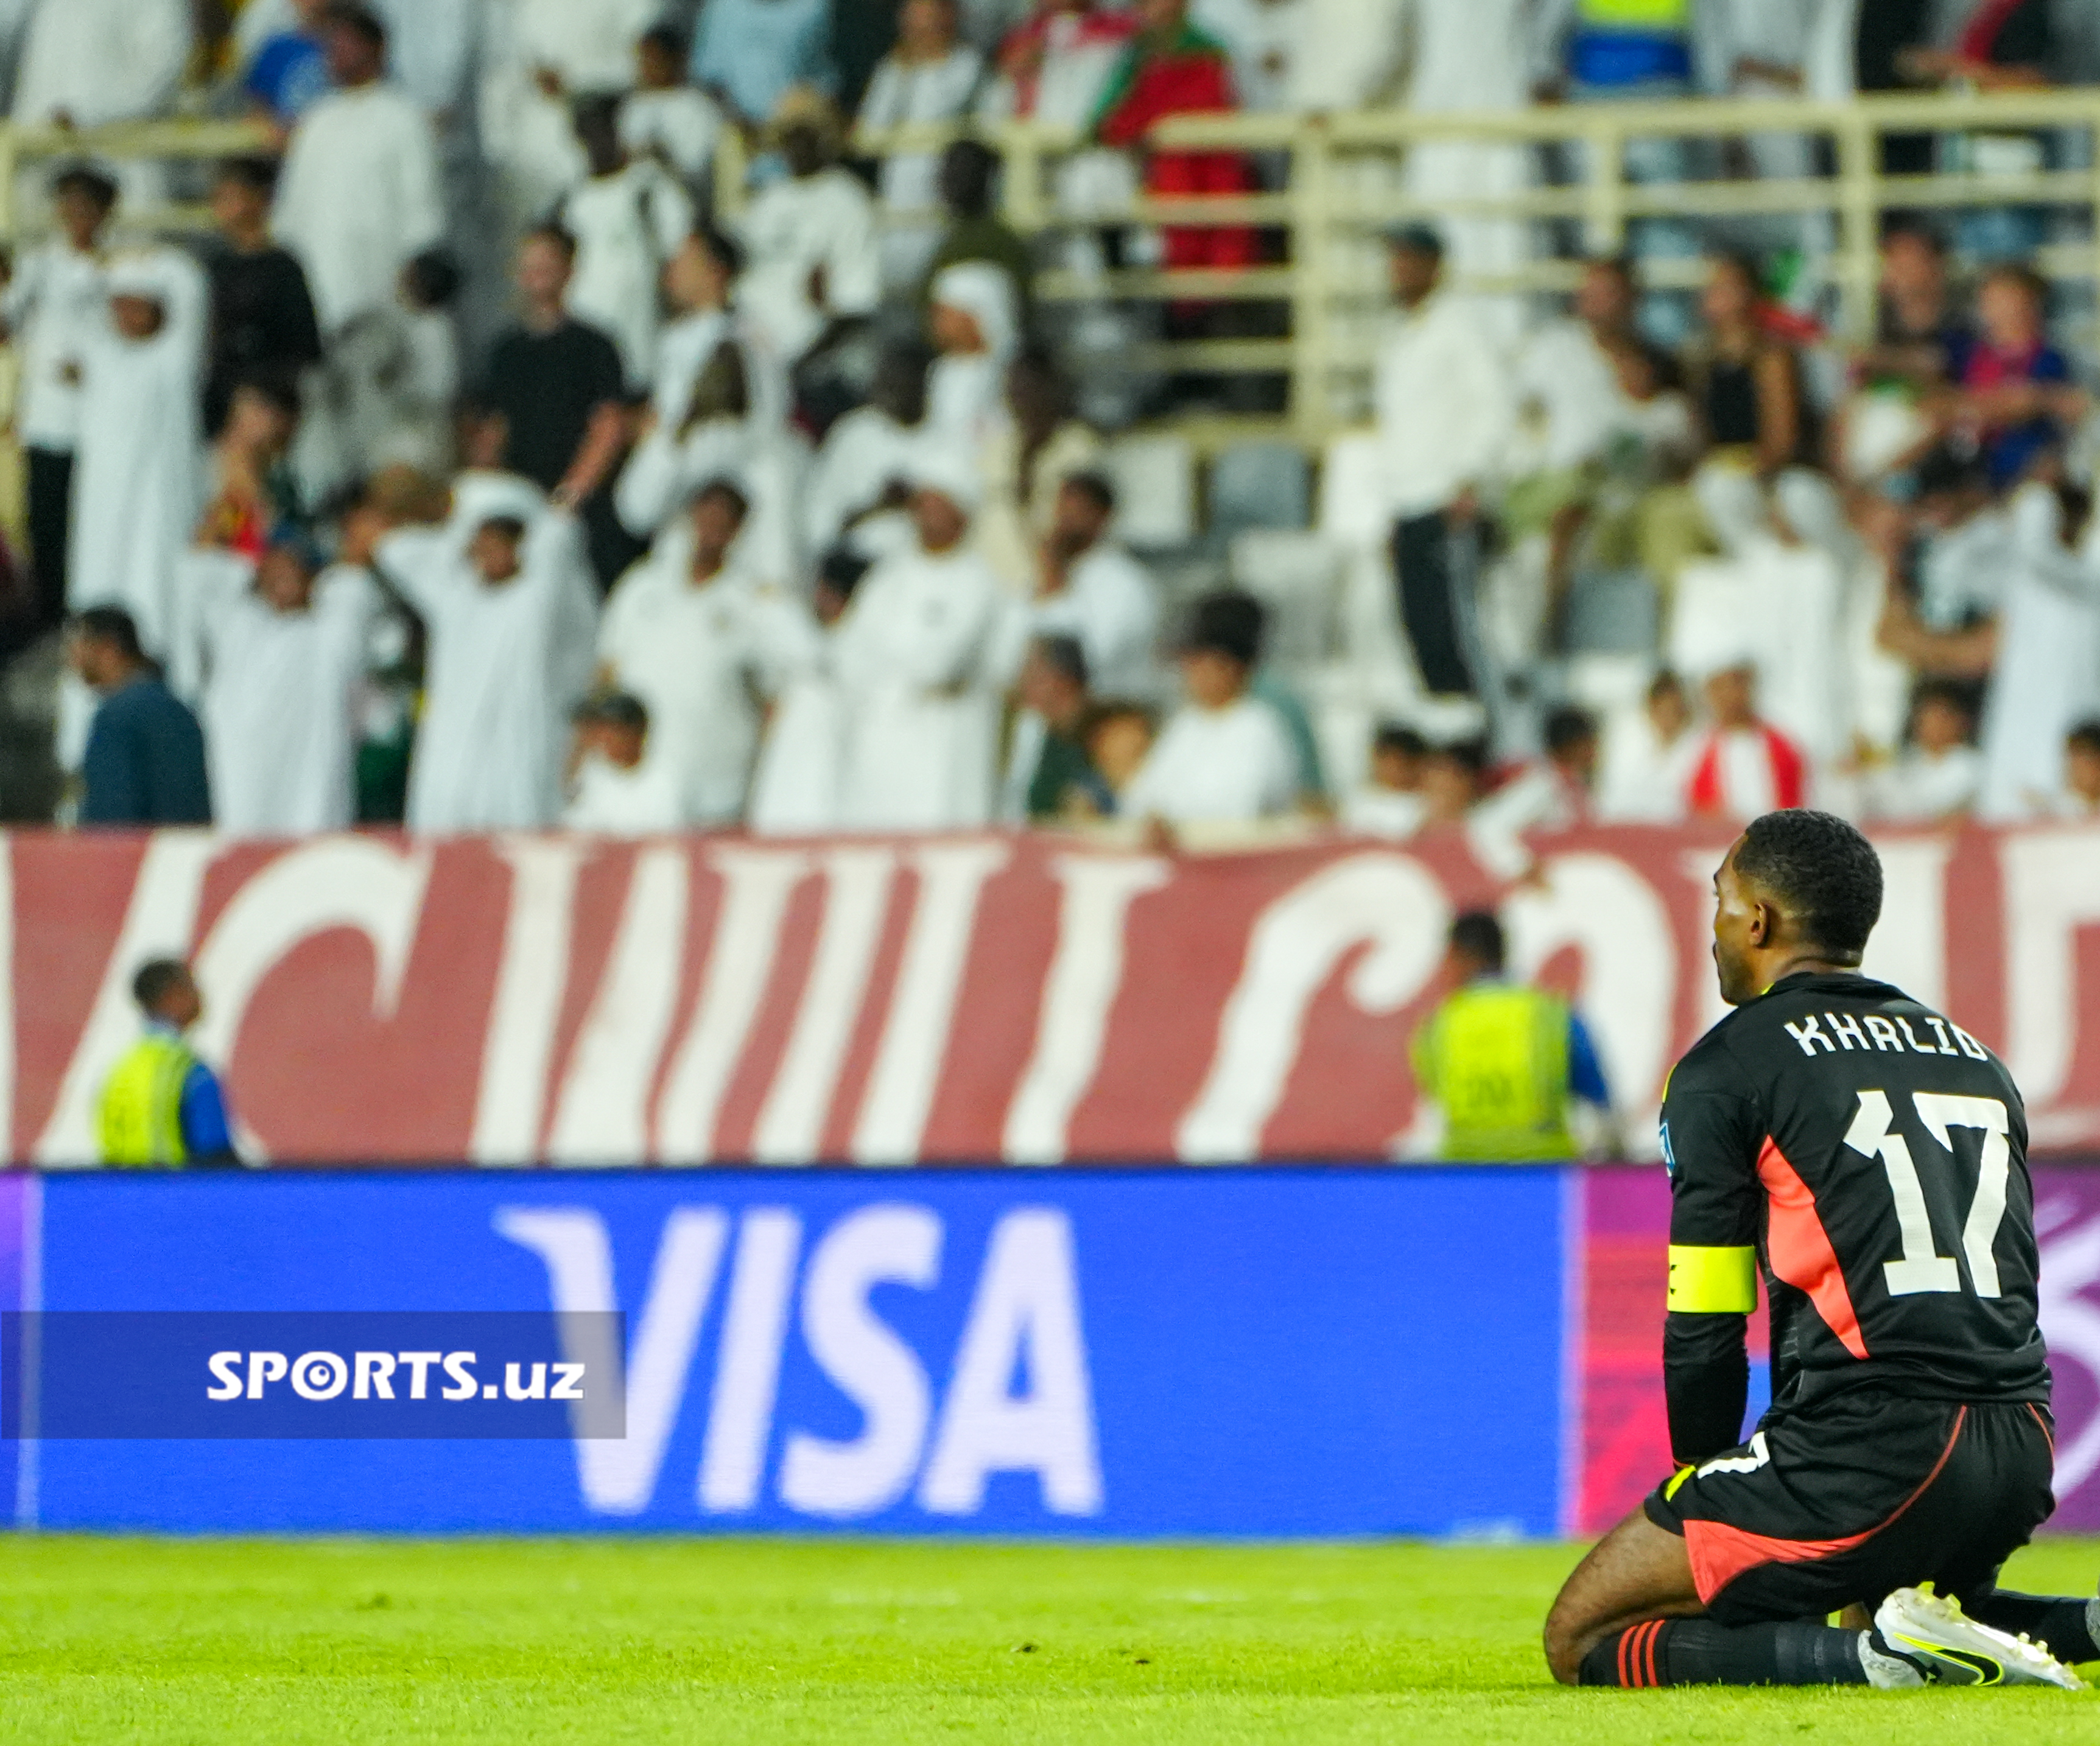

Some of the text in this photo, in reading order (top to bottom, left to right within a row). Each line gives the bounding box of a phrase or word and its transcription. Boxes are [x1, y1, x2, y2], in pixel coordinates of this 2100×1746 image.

[1783, 1012, 1988, 1062] KHALID
[1843, 1090, 2010, 1299] 17
[494, 1204, 1103, 1516] VISA
